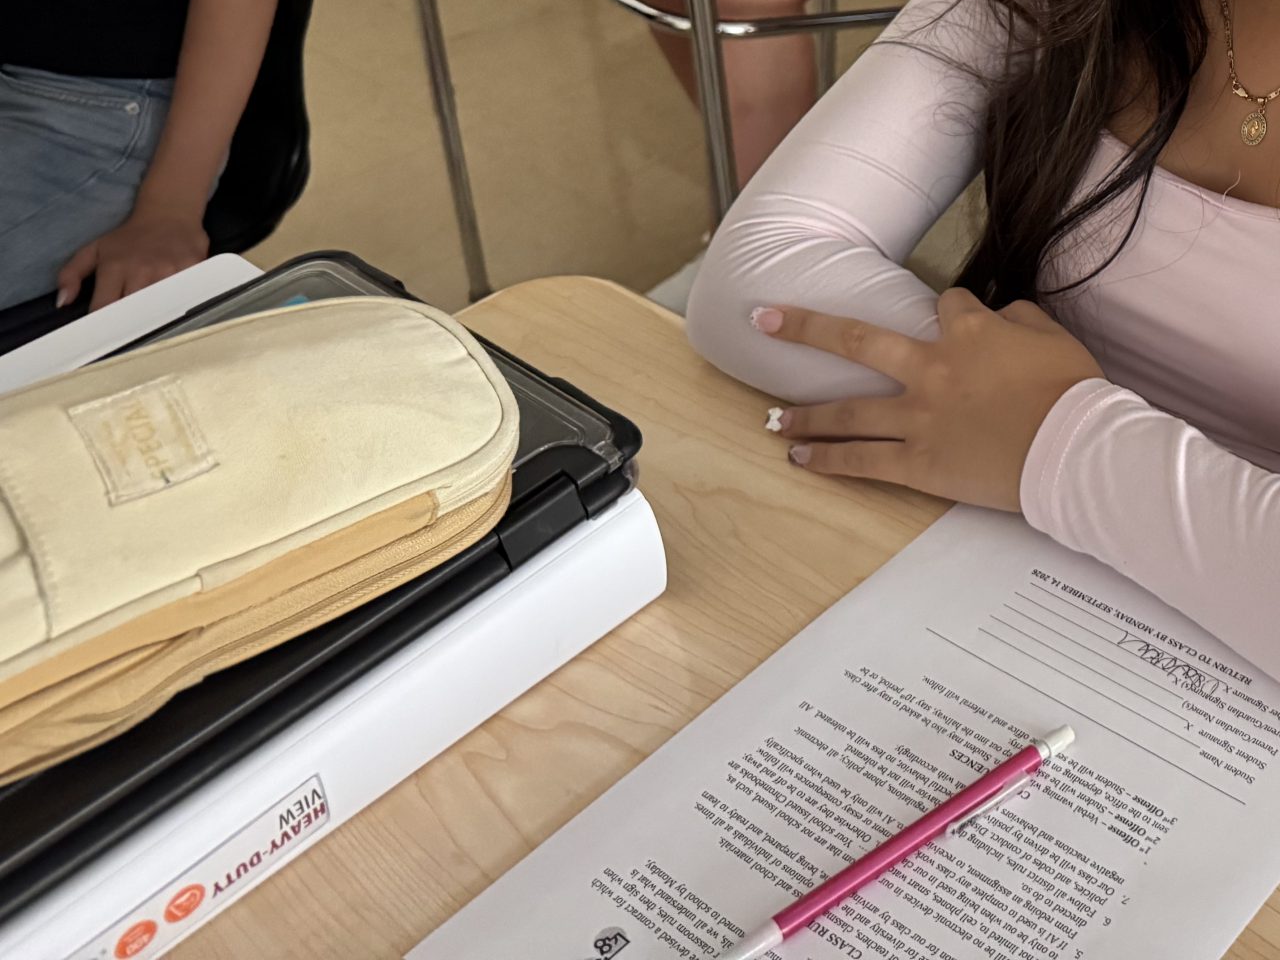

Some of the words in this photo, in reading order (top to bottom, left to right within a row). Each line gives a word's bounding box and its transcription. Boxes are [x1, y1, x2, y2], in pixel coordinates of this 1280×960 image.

[1060, 583, 1113, 613] SEPTEMBER
[1112, 608, 1154, 634] MONDAY,
[1152, 631, 1168, 642] BY
[1166, 638, 1197, 657] CLASS
[1197, 653, 1212, 665] TO
[859, 666, 870, 676] be
[1211, 661, 1252, 685] RETURN
[860, 680, 878, 693] after
[877, 676, 904, 694] period,
[921, 675, 946, 694] follow.
[876, 689, 893, 702] stay
[891, 699, 901, 707] to
[943, 689, 960, 701] will
[1231, 689, 1269, 712] Signature
[898, 704, 922, 719] asked
[915, 699, 932, 711] stay
[958, 698, 988, 716] referral
[1181, 700, 1215, 723] Name(s)
[920, 716, 931, 727] be
[930, 722, 947, 734] also
[931, 707, 962, 731] hallway,
[991, 716, 1008, 727] and
[793, 726, 829, 750] electronic
[946, 730, 964, 744] may
[960, 725, 974, 736] the
[973, 733, 990, 745] into
[1007, 724, 1029, 740] office
[1214, 718, 1278, 756] Parent/Guardian
[988, 741, 1002, 752] out
[1198, 729, 1235, 753] Signature
[825, 747, 839, 757] all
[962, 740, 992, 761] Student
[1198, 749, 1224, 767] Name
[1234, 748, 1267, 769] Student
[839, 753, 865, 773] policy,
[1050, 762, 1062, 772] on
[1067, 758, 1079, 770] be
[1076, 764, 1094, 777] will
[862, 770, 888, 787] phone
[937, 770, 954, 783] with
[948, 749, 1032, 800] CUENCES
[1049, 776, 1061, 788] be
[1061, 768, 1102, 796] depending
[1223, 762, 1255, 784] Student
[1058, 782, 1076, 795] will
[1094, 773, 1125, 795] Student
[886, 783, 928, 813] regulations,
[1041, 784, 1073, 808] warning
[1076, 791, 1107, 813] Student
[1104, 791, 1128, 810] office,
[278, 788, 323, 830] VIEW
[1072, 804, 1098, 824] Verbal
[1127, 806, 1142, 818] the
[1131, 794, 1164, 817] Offense
[1000, 808, 1038, 835] behaviors
[1113, 813, 1146, 836] Offense
[1141, 814, 1151, 824] to
[1150, 819, 1169, 833] sent
[1035, 830, 1054, 842] and
[1106, 824, 1140, 847] Offense
[212, 801, 326, 898] HEAVY-DUTY
[718, 836, 754, 864] materials.
[966, 833, 1005, 861] including
[1053, 839, 1090, 864] reactions
[629, 868, 640, 879] is
[644, 859, 677, 888] Monday,
[749, 861, 778, 881] school
[1006, 855, 1027, 874] rules,
[1089, 860, 1124, 885] negative
[602, 867, 623, 885] when
[636, 873, 656, 891] what
[773, 878, 793, 891] and
[1026, 870, 1055, 892] district
[590, 877, 614, 897] which
[622, 881, 640, 897] sign
[673, 883, 687, 897] by
[1021, 882, 1033, 894] so.
[1031, 890, 1044, 902] do
[1052, 888, 1067, 899] all
[611, 894, 627, 908] for
[638, 893, 656, 911] then
[652, 888, 696, 921] understand
[682, 891, 712, 913] school
[1043, 897, 1054, 907] to
[1066, 896, 1097, 918] Follow
[623, 903, 656, 929] contract
[656, 906, 677, 926] rules,
[692, 918, 708, 929] all
[710, 910, 720, 920] to
[1050, 903, 1087, 927] directed
[1102, 916, 1111, 926] 6.
[653, 926, 662, 934] a
[705, 926, 719, 939] we
[716, 916, 745, 938] turned
[656, 930, 690, 957] devised
[675, 922, 714, 954] classroom
[854, 928, 889, 957] teachers,
